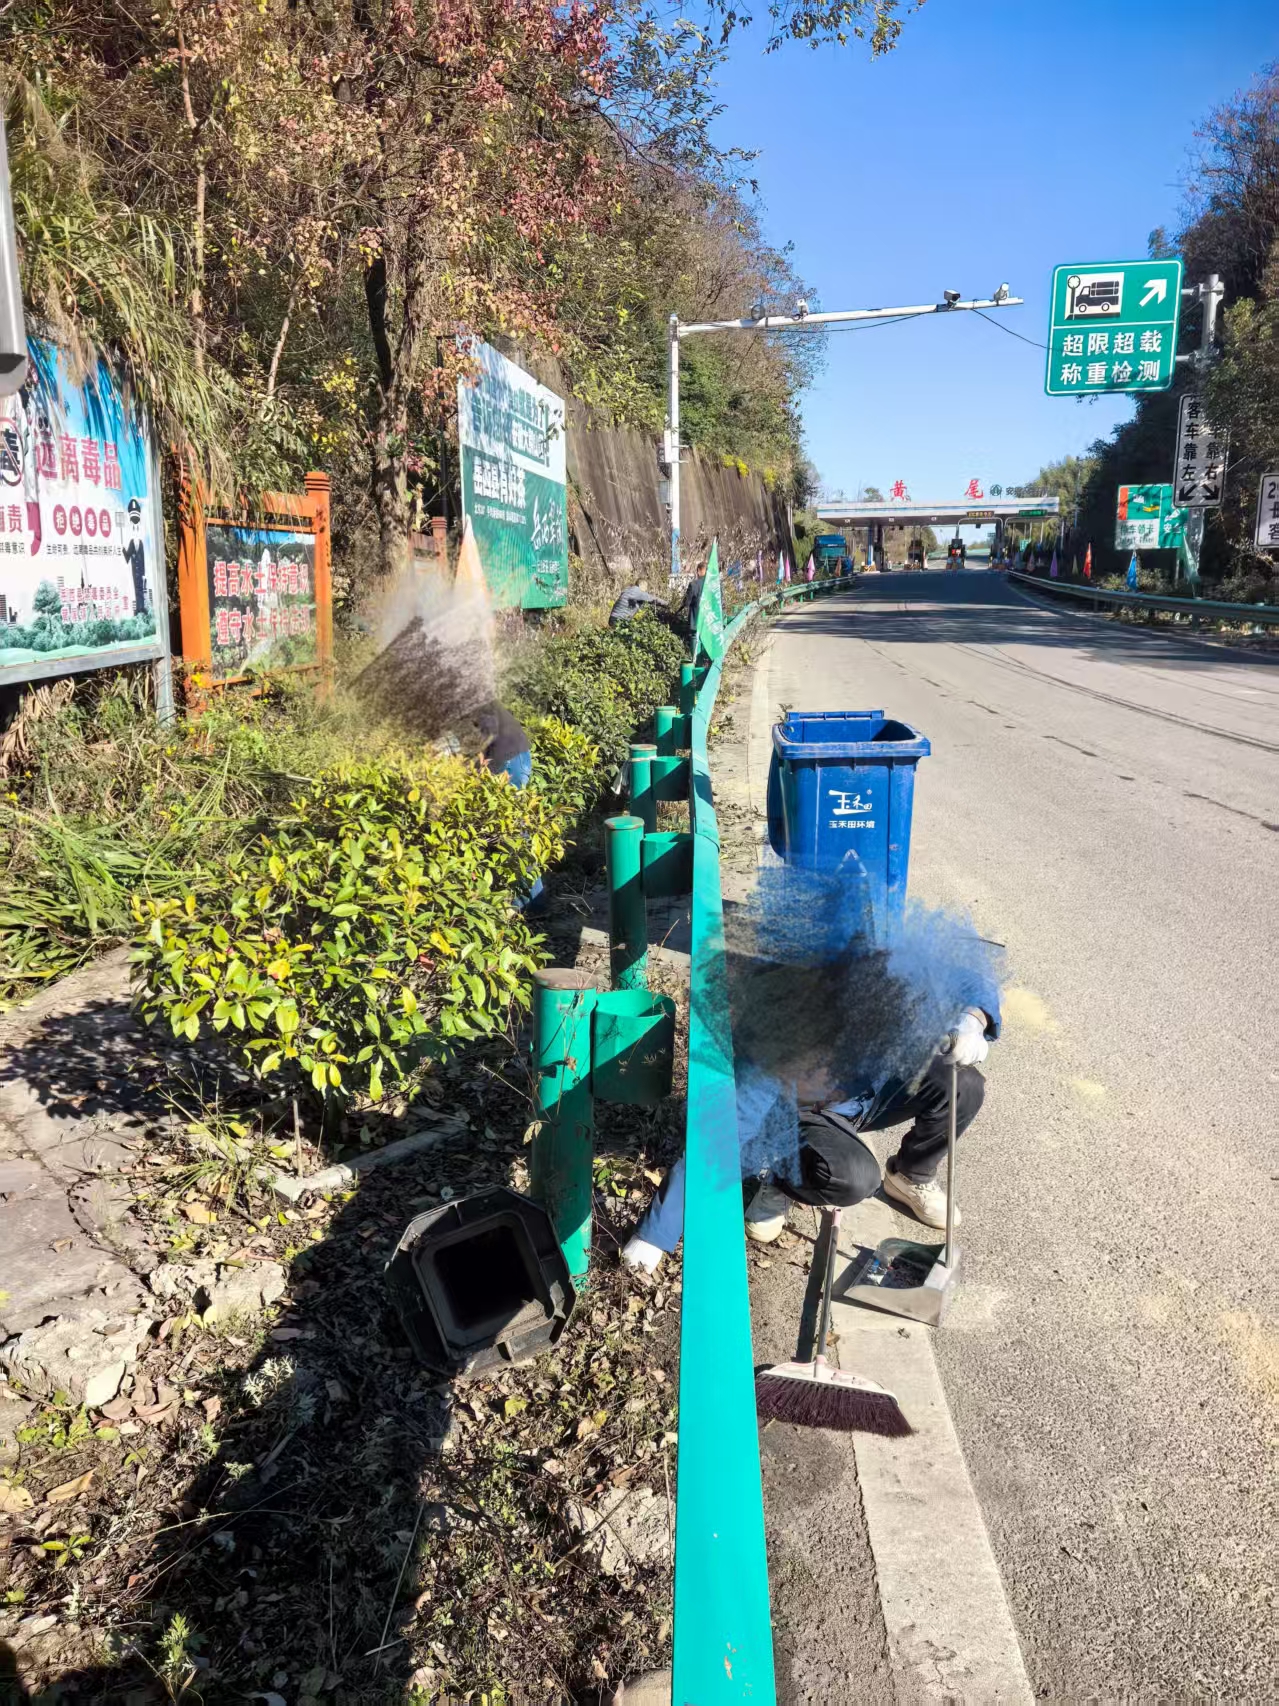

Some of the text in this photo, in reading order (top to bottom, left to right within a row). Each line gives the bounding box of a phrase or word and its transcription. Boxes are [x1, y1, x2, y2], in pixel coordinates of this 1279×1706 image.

[1062, 329, 1162, 358] 超限超载
[1060, 359, 1161, 386] 称重检测
[1181, 402, 1201, 482] 客车靠左
[35, 431, 122, 490] 远离毒品
[889, 479, 911, 501] 黄
[964, 479, 984, 500] 尾
[54, 508, 111, 534] 拒绝毒品
[828, 820, 876, 829] 玉禾田环境
